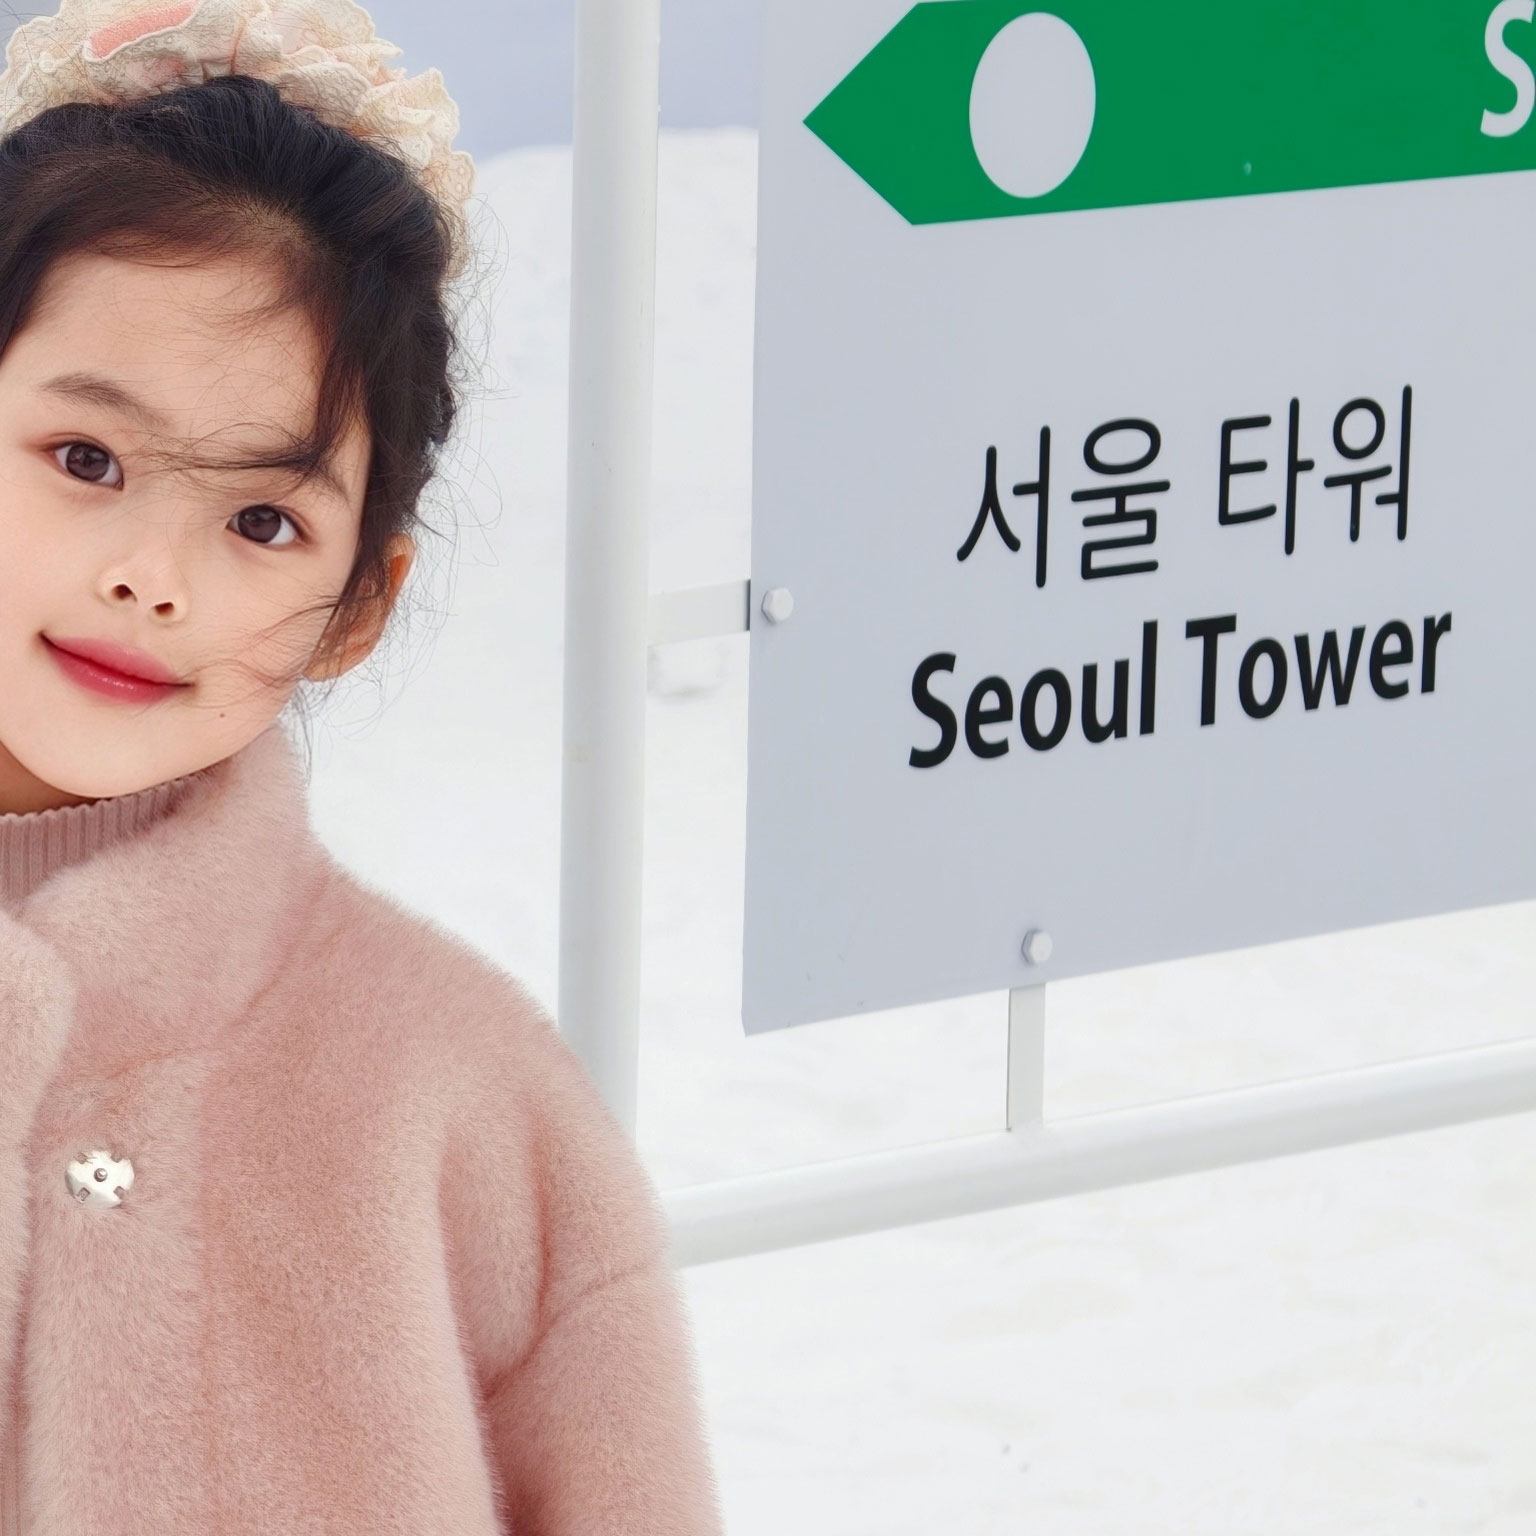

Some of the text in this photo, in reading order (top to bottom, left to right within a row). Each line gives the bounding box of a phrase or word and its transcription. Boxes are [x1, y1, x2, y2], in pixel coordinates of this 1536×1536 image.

[956, 384, 1413, 590] 서울 타워
[908, 611, 1453, 770] Seoul Tower
